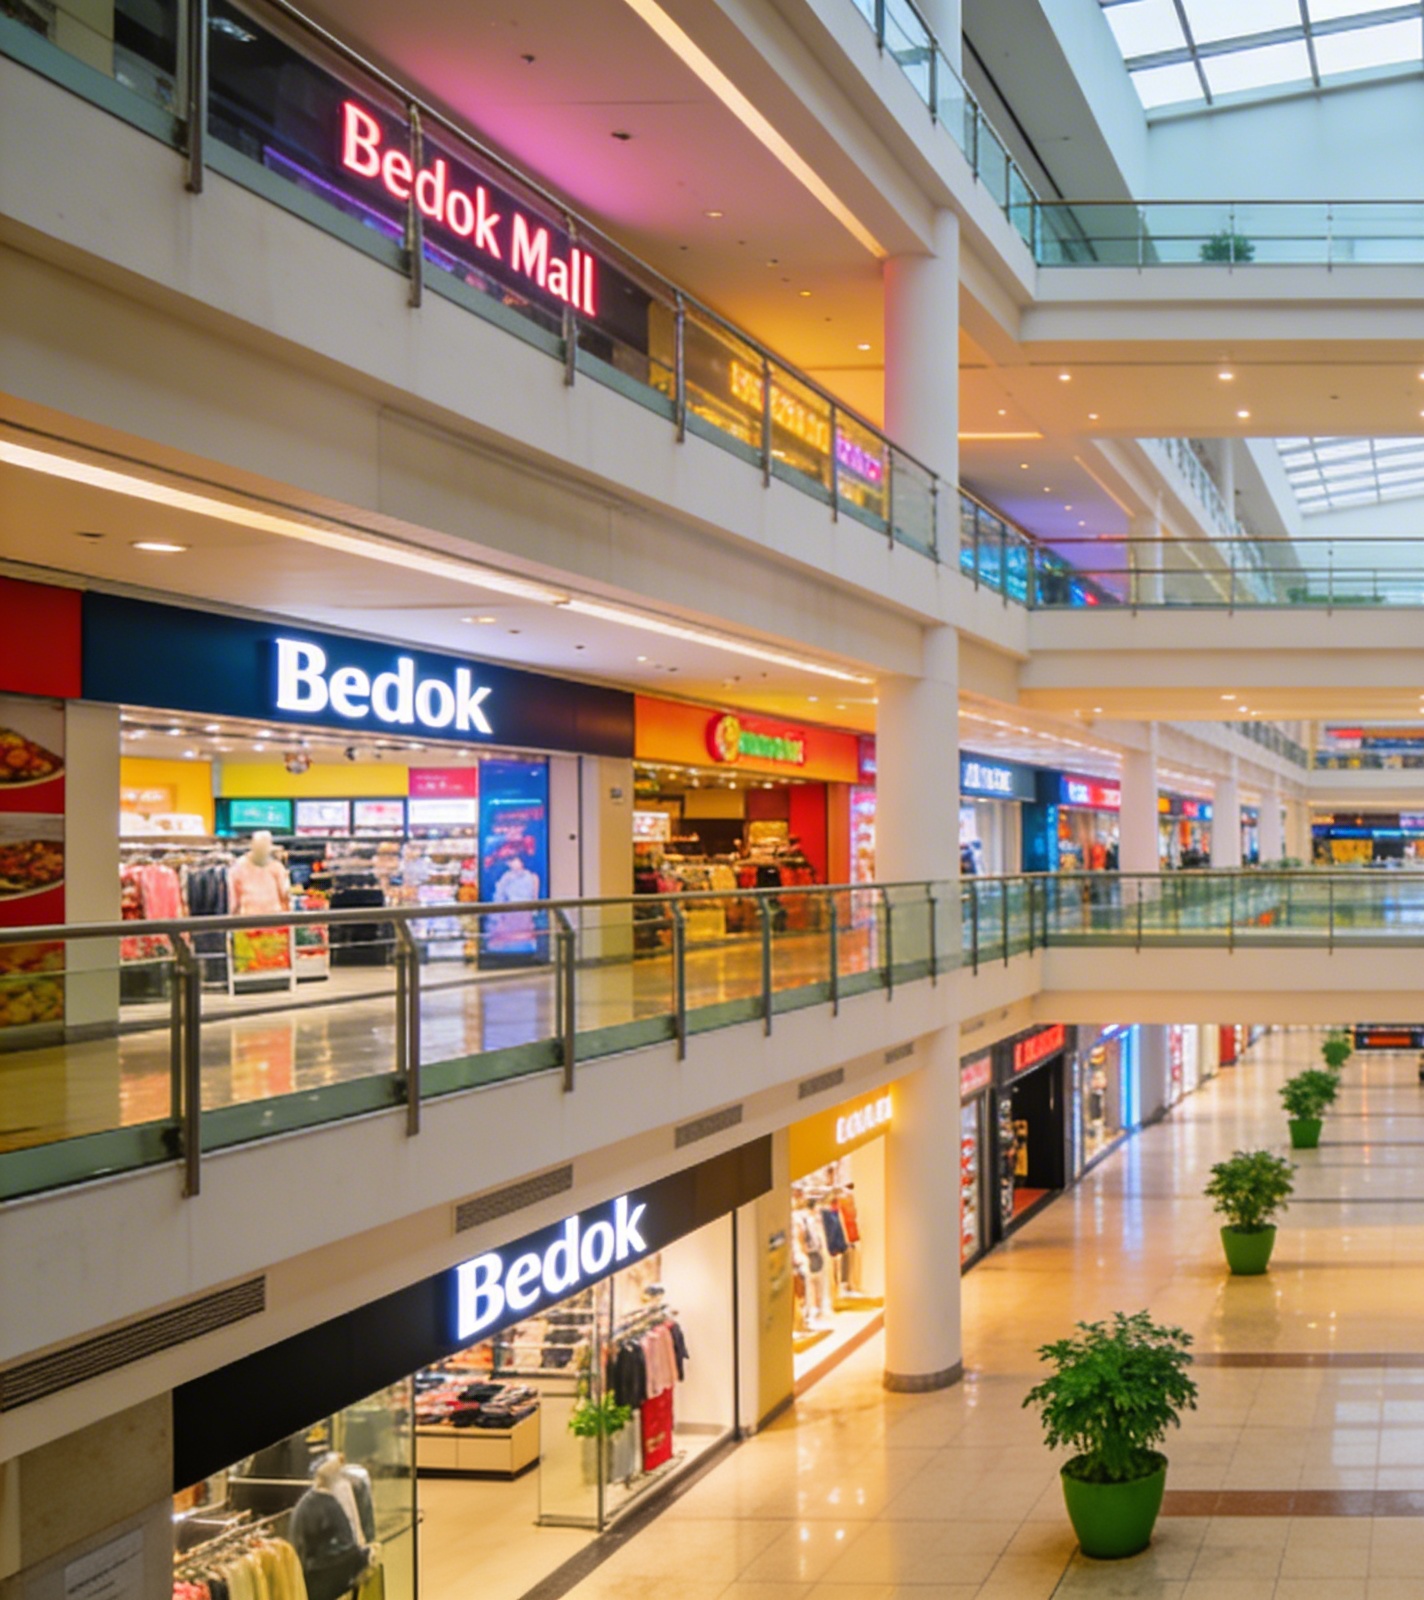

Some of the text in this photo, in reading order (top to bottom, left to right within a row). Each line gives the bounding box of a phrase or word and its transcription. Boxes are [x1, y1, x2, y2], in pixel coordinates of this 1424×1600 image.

[342, 101, 596, 317] Bedok Mall
[275, 637, 493, 735] Bedok
[456, 1194, 648, 1341] Bedok
